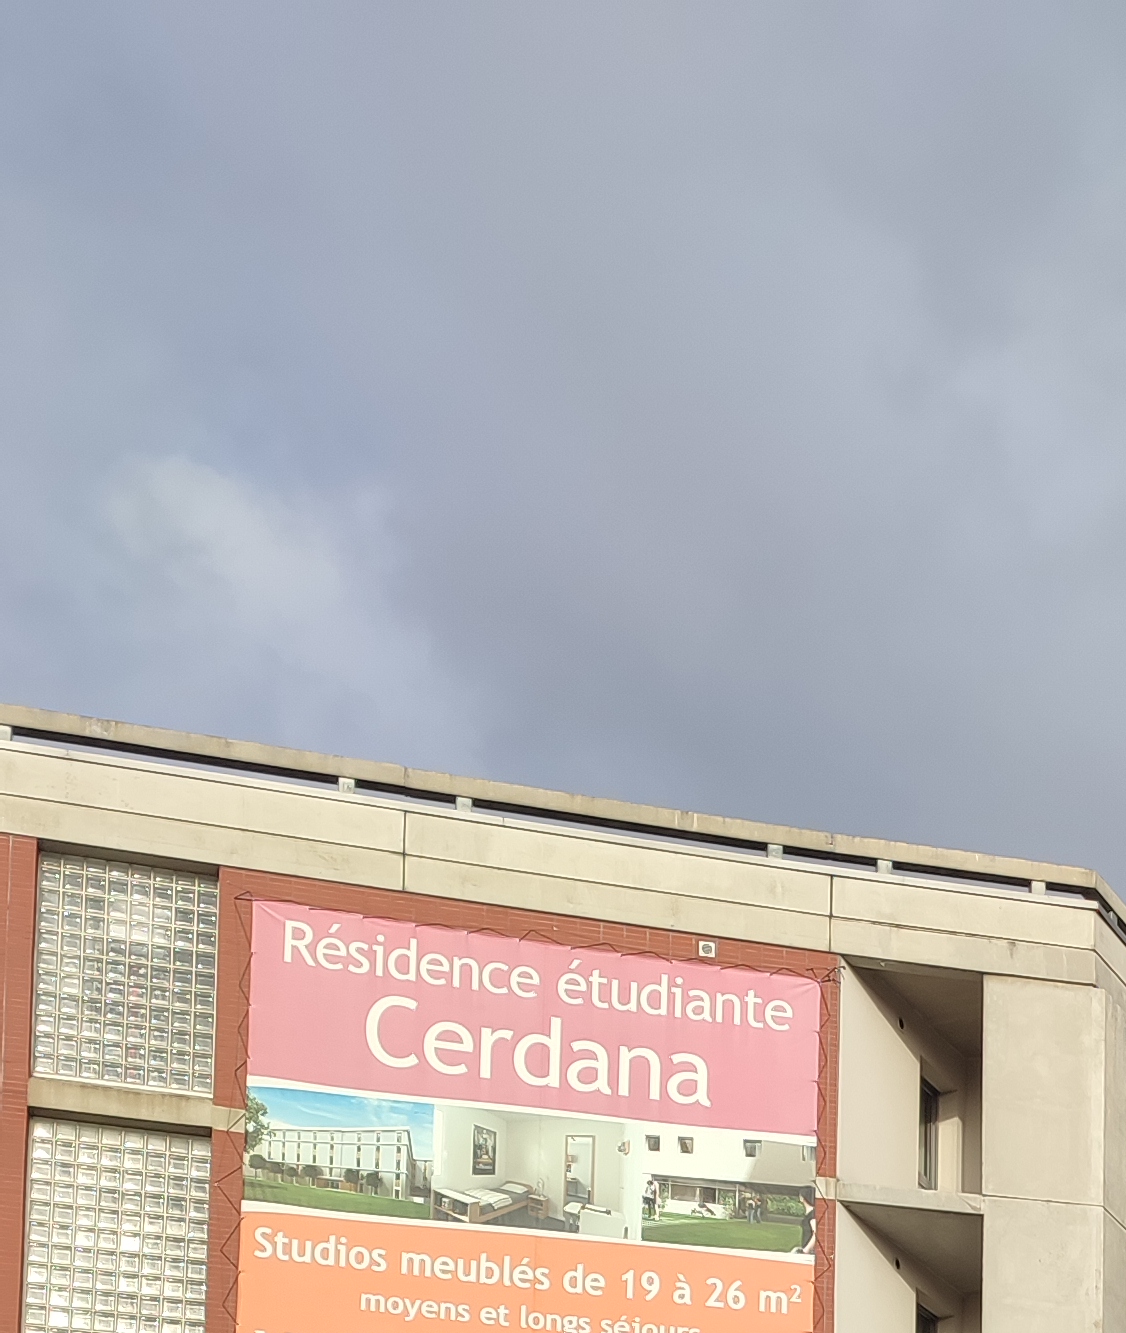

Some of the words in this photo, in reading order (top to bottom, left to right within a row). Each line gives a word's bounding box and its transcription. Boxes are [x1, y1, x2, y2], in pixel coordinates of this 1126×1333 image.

[282, 918, 542, 998] Résidence
[556, 957, 795, 1032] étudiante
[364, 994, 713, 1109] Cerdana
[253, 1226, 388, 1273] Studios
[400, 1250, 552, 1291] meublés
[562, 1262, 607, 1296] de
[621, 1269, 662, 1301] 19
[672, 1272, 693, 1305] à
[704, 1277, 747, 1311] 26
[759, 1284, 803, 1316] m²
[360, 1292, 472, 1323] moyens
[479, 1303, 511, 1327] et
